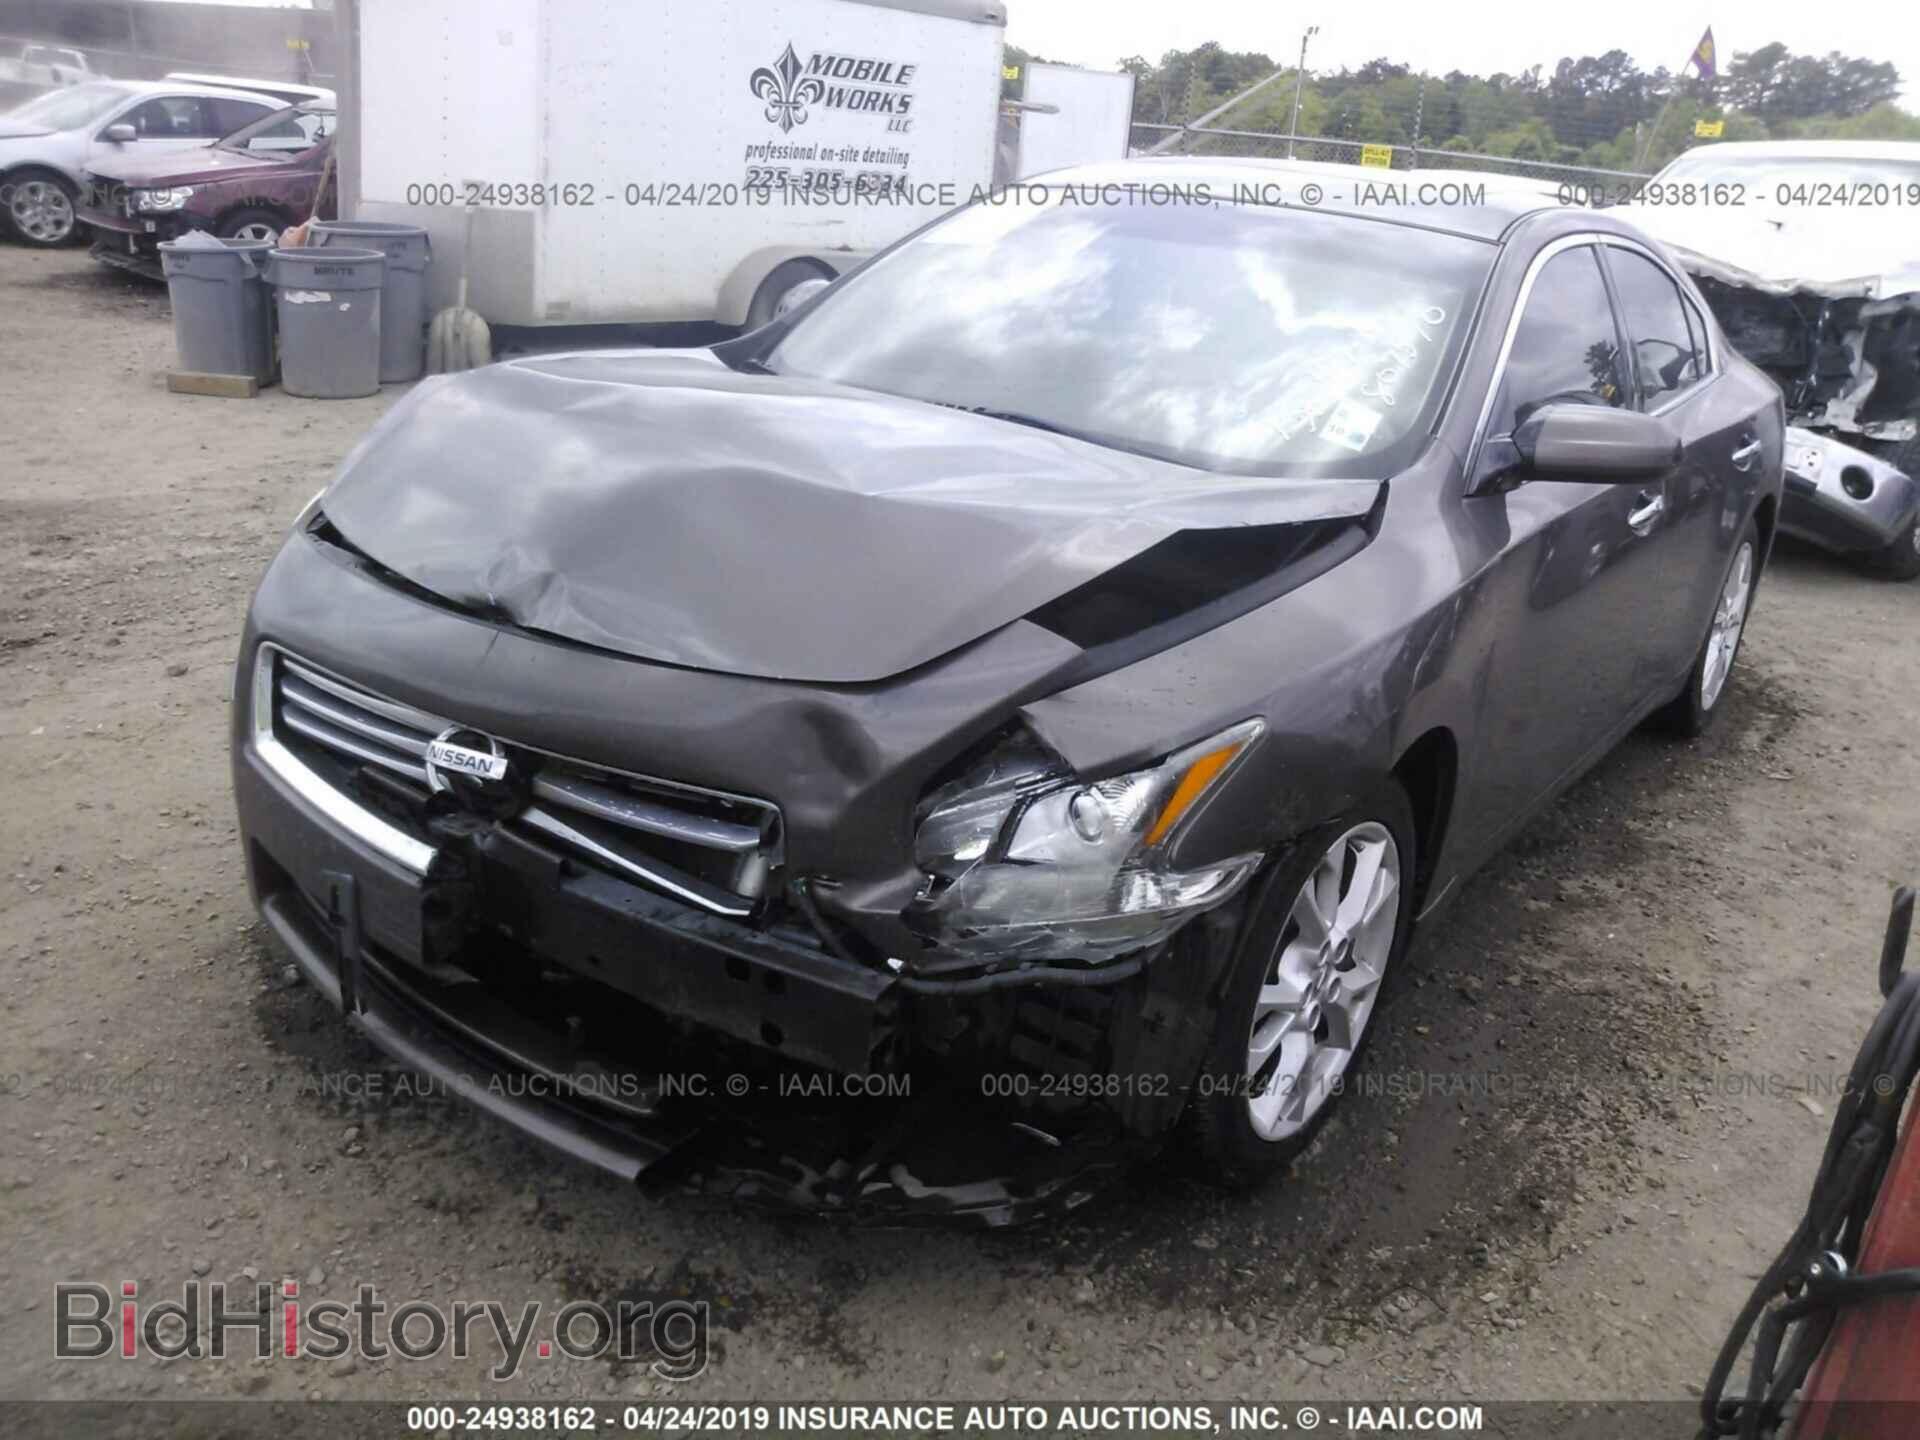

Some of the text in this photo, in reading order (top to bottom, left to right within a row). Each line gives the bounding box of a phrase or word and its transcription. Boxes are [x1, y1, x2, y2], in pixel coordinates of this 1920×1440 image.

[804, 54, 915, 86] MOBILE
[825, 86, 913, 115] WORKS
[887, 118, 913, 134] LLC
[744, 140, 910, 170] professional on-site detailing
[429, 744, 494, 774] NISSAN
